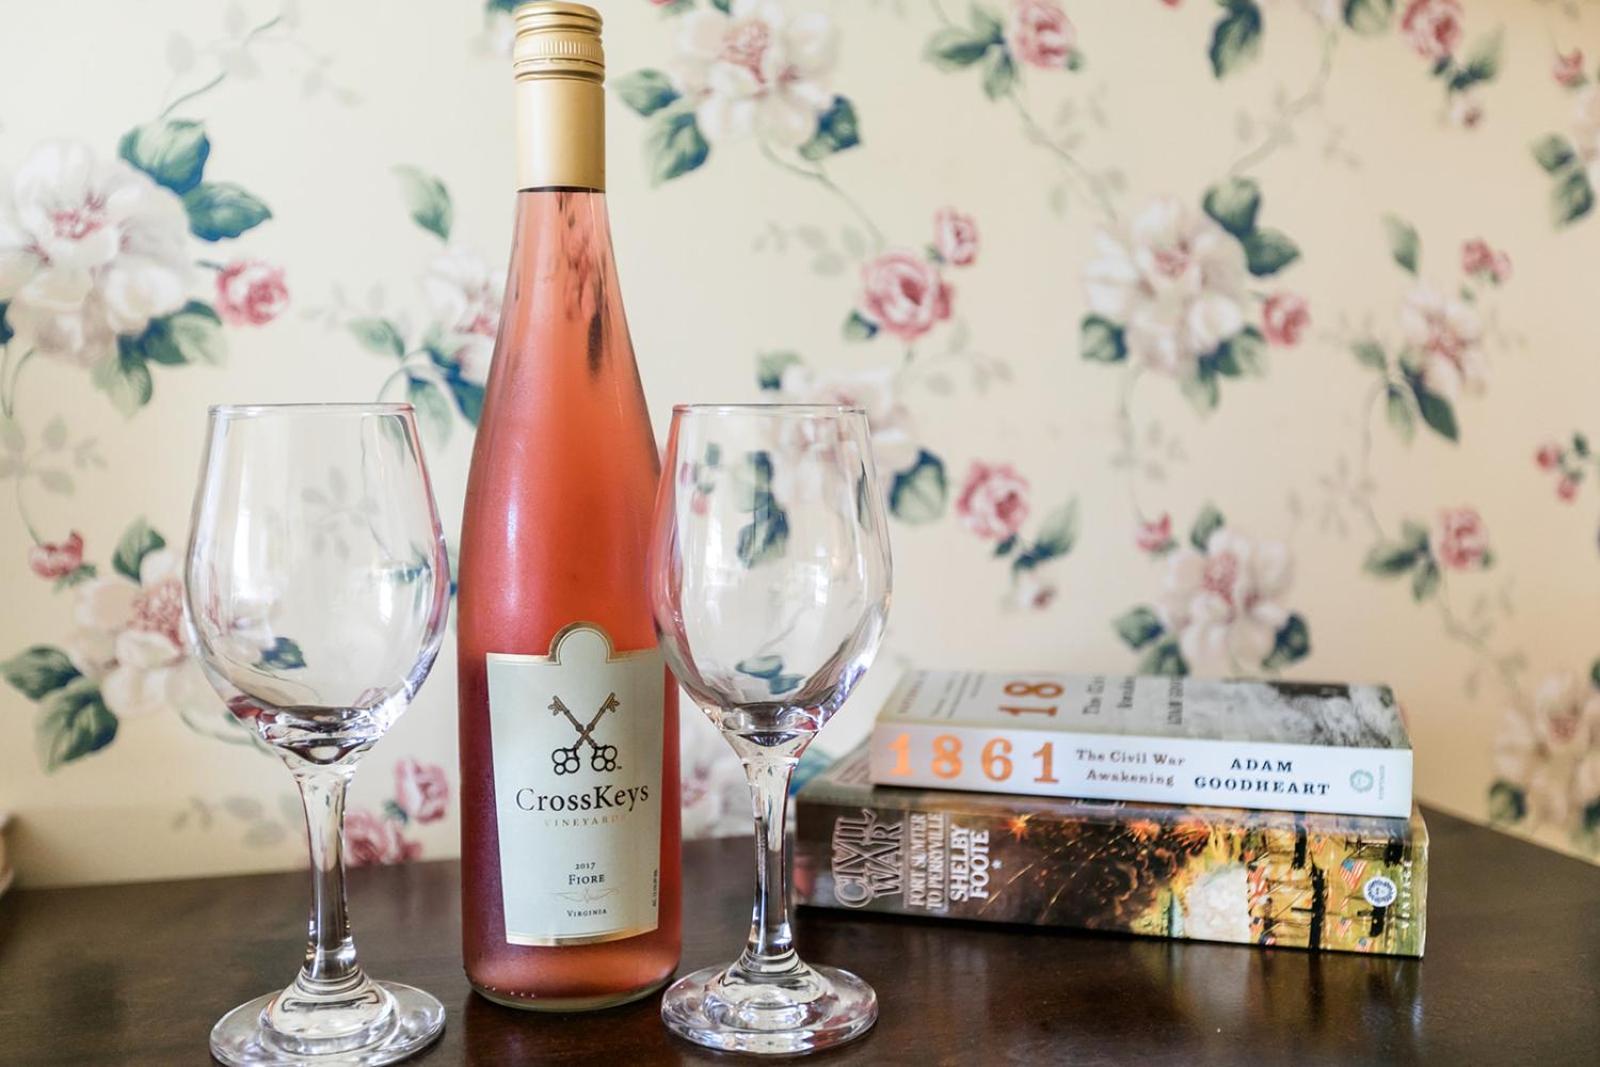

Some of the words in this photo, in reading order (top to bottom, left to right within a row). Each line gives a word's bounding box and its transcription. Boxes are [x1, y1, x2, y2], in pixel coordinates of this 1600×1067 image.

[888, 731, 1060, 784] 1861
[1076, 748, 1105, 761] The
[1110, 750, 1147, 764] Civil
[1153, 753, 1186, 766] War
[1231, 758, 1292, 772] ADAM
[1086, 769, 1175, 787] Awakening
[1194, 776, 1330, 795] GOODHEART
[515, 784, 649, 812] CrossKeys
[910, 814, 927, 868] SUMTER
[927, 813, 945, 889] PERRYVILLE
[575, 862, 596, 870] 2017
[832, 808, 877, 908] CIVIL
[868, 822, 903, 898] WAR
[950, 824, 969, 902] SHELBY
[970, 829, 990, 899] FOOTE
[909, 869, 926, 906] FORT
[927, 892, 943, 909] TO
[566, 909, 607, 917] VIRGINIA
